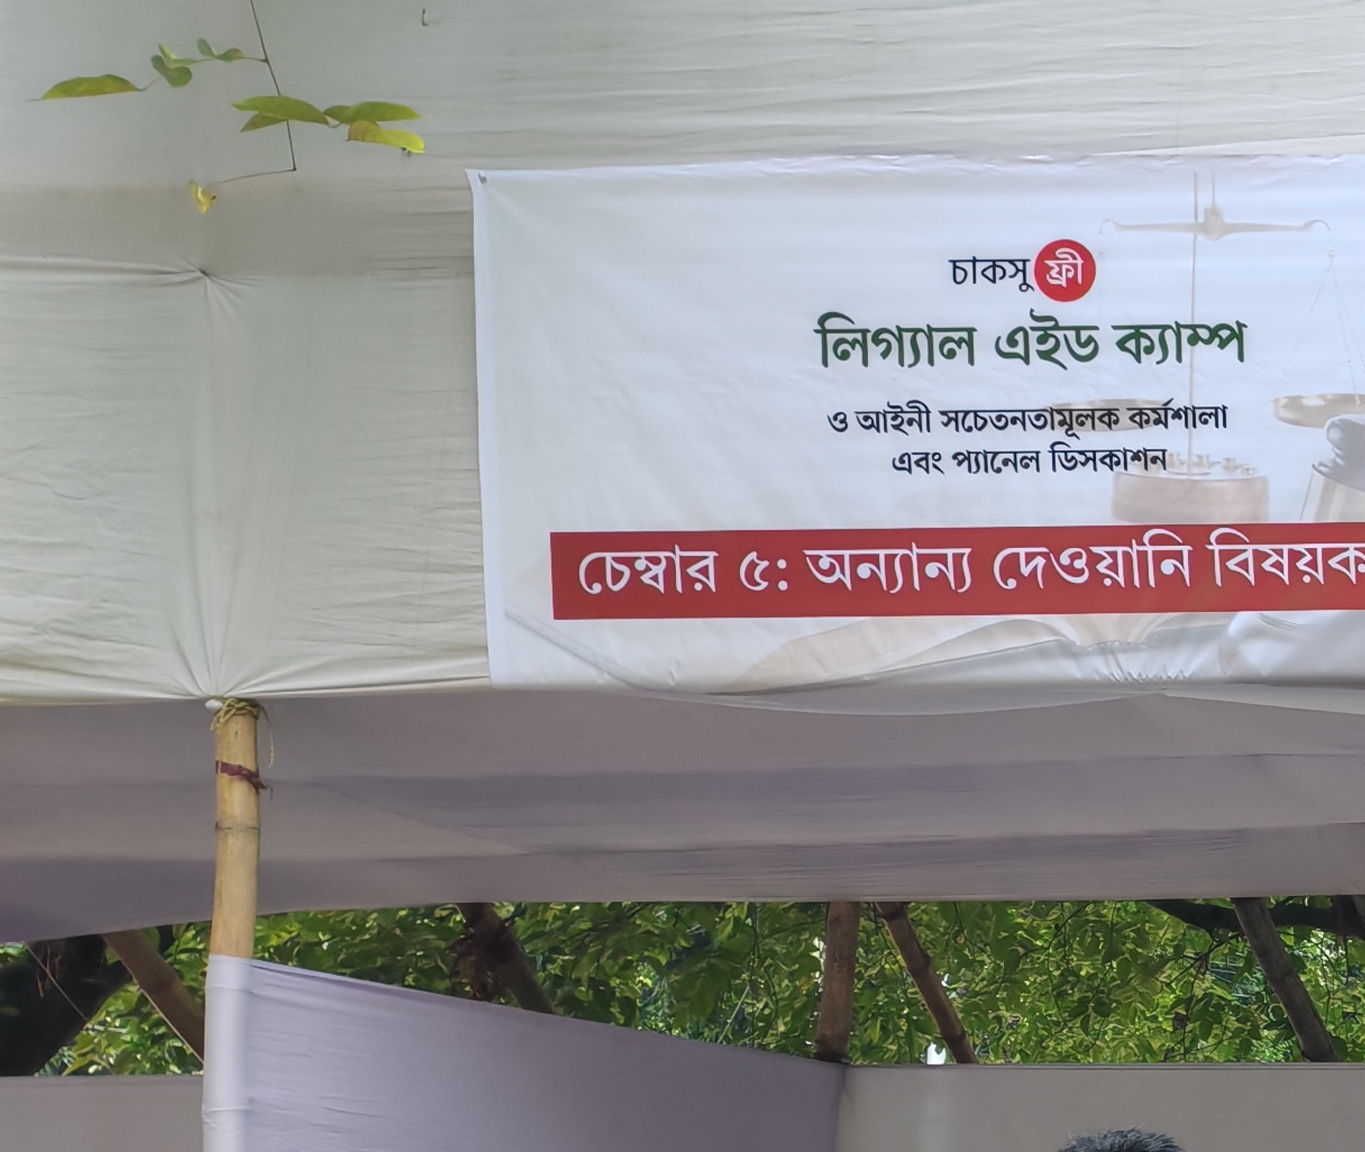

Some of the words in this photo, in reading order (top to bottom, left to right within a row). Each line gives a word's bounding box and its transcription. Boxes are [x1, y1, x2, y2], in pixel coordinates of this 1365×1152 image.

[948, 255, 1033, 293] চাকসু
[1044, 247, 1084, 287] ফ্রী
[813, 311, 978, 369] লিগ্যাল
[994, 308, 1100, 371] এইড
[1111, 320, 1248, 365] ক্যাম্প
[827, 411, 849, 433] ও
[855, 399, 932, 436] আইনী
[937, 406, 1121, 441] সচেতনতামূলক
[1126, 397, 1229, 430] কর্মশালা
[891, 451, 945, 475] এবং
[951, 449, 1041, 474] প্যানেল
[1047, 440, 1168, 473] ডিসকাশন
[579, 544, 719, 594] চেম্বার
[739, 551, 788, 591] ৫:
[803, 542, 972, 594] অন্যান্য
[993, 528, 1193, 589] দেওয়ানি
